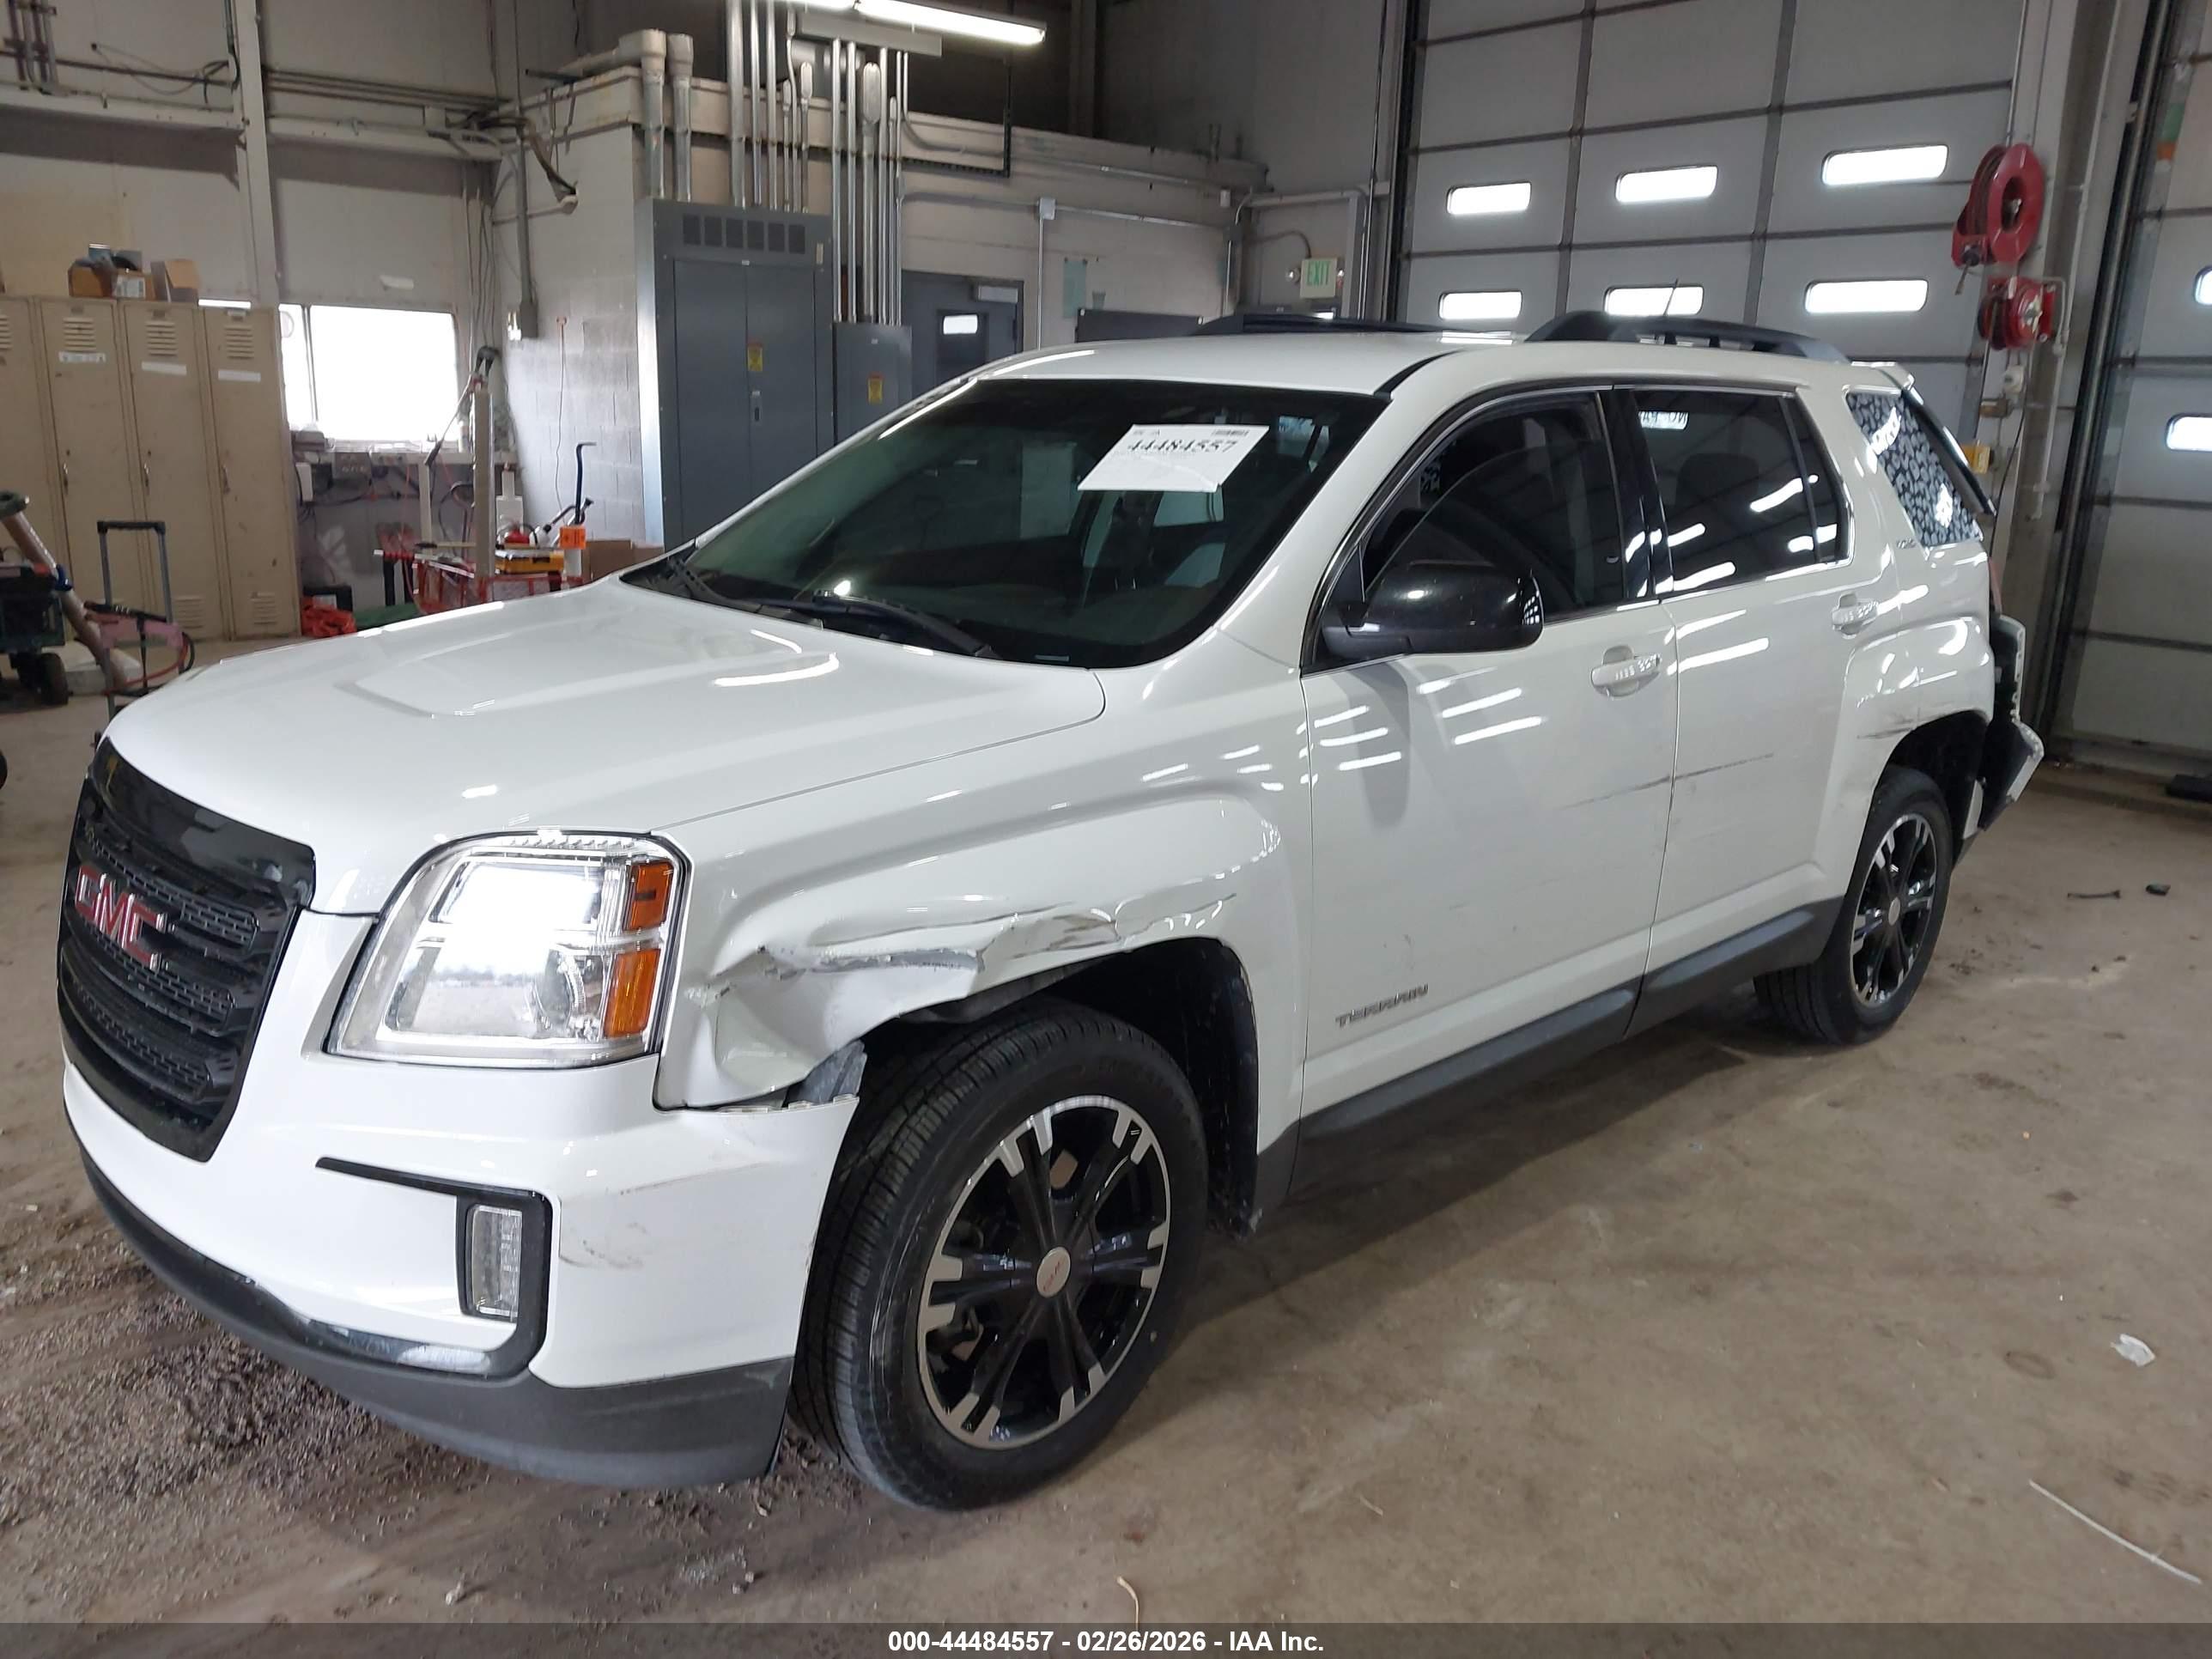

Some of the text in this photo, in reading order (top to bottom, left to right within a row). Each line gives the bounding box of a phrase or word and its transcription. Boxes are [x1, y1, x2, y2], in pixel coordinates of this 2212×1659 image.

[1305, 259, 1331, 286] EXIT
[1127, 439, 1238, 453] 44484557
[75, 865, 167, 973] GMC
[1335, 983, 1429, 1028] TERRAIN
